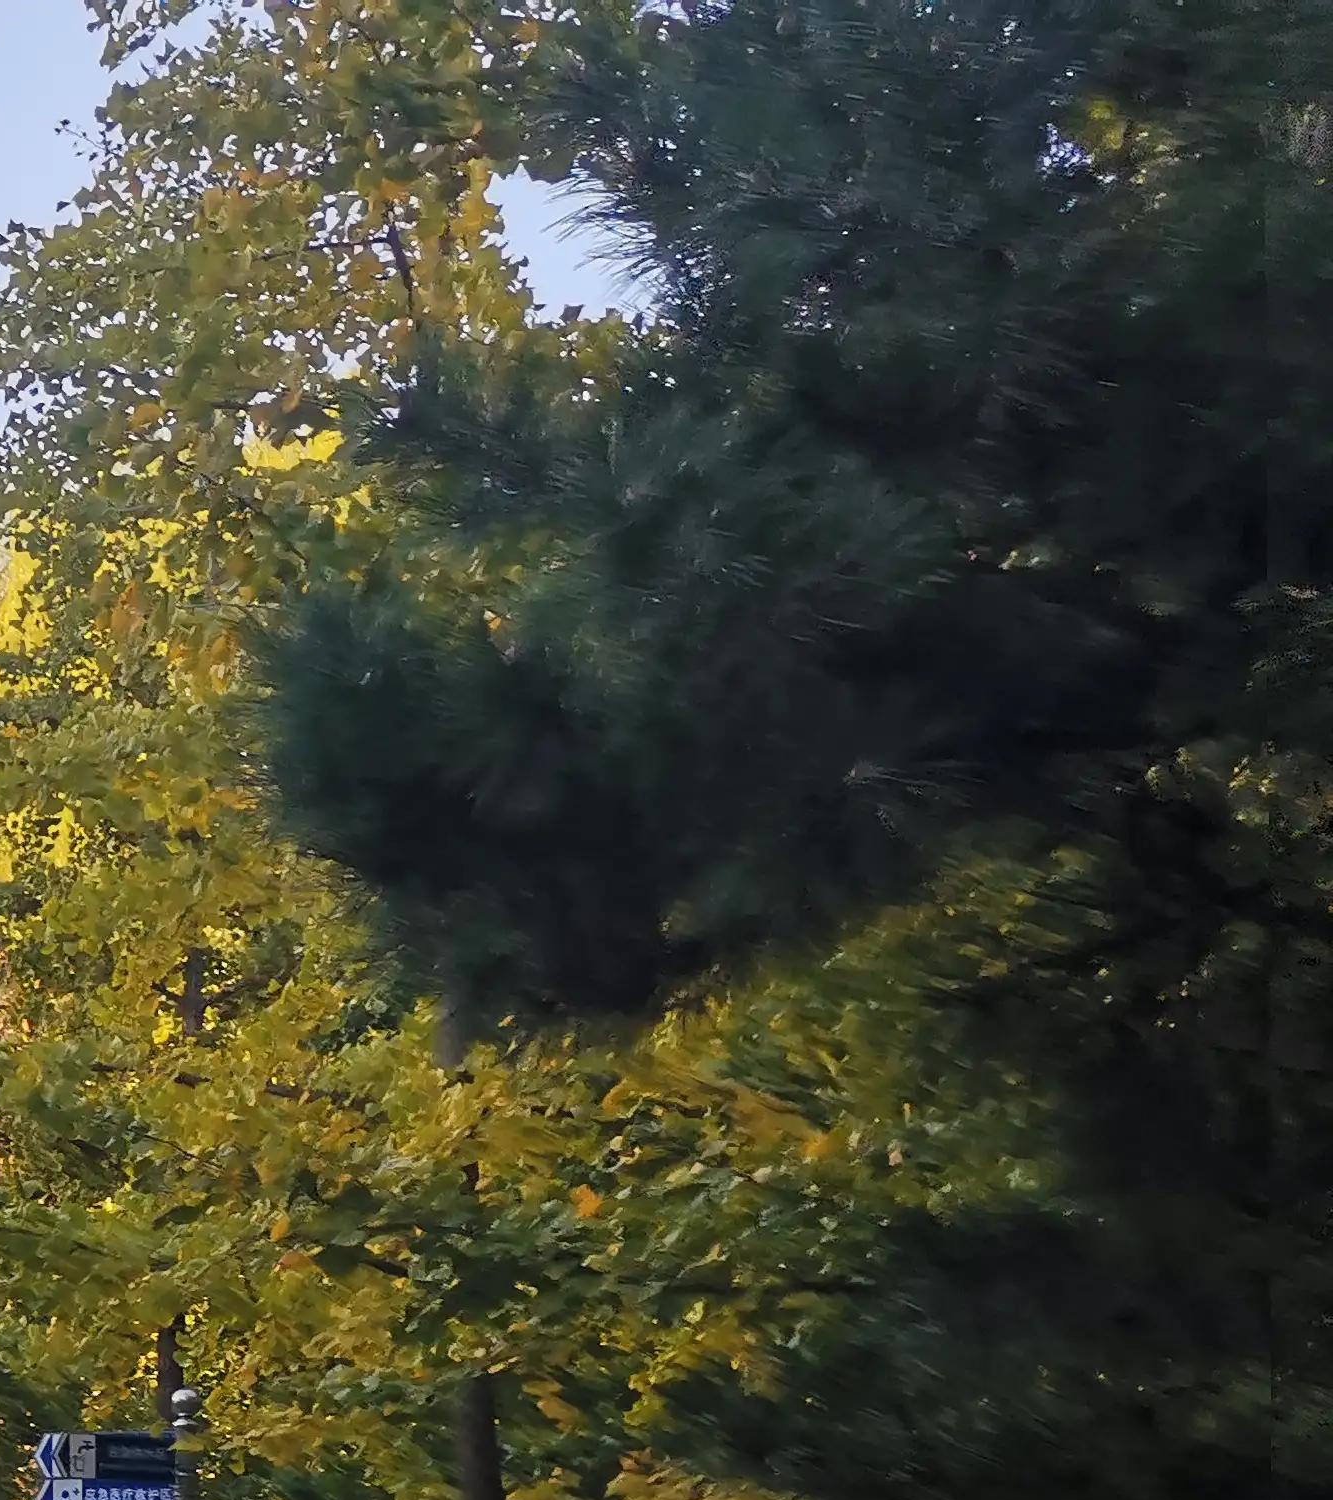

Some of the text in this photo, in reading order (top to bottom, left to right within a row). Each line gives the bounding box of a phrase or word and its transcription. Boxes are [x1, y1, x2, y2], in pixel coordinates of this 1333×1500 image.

[84, 1487, 173, 1500] 应急医疗救护区
